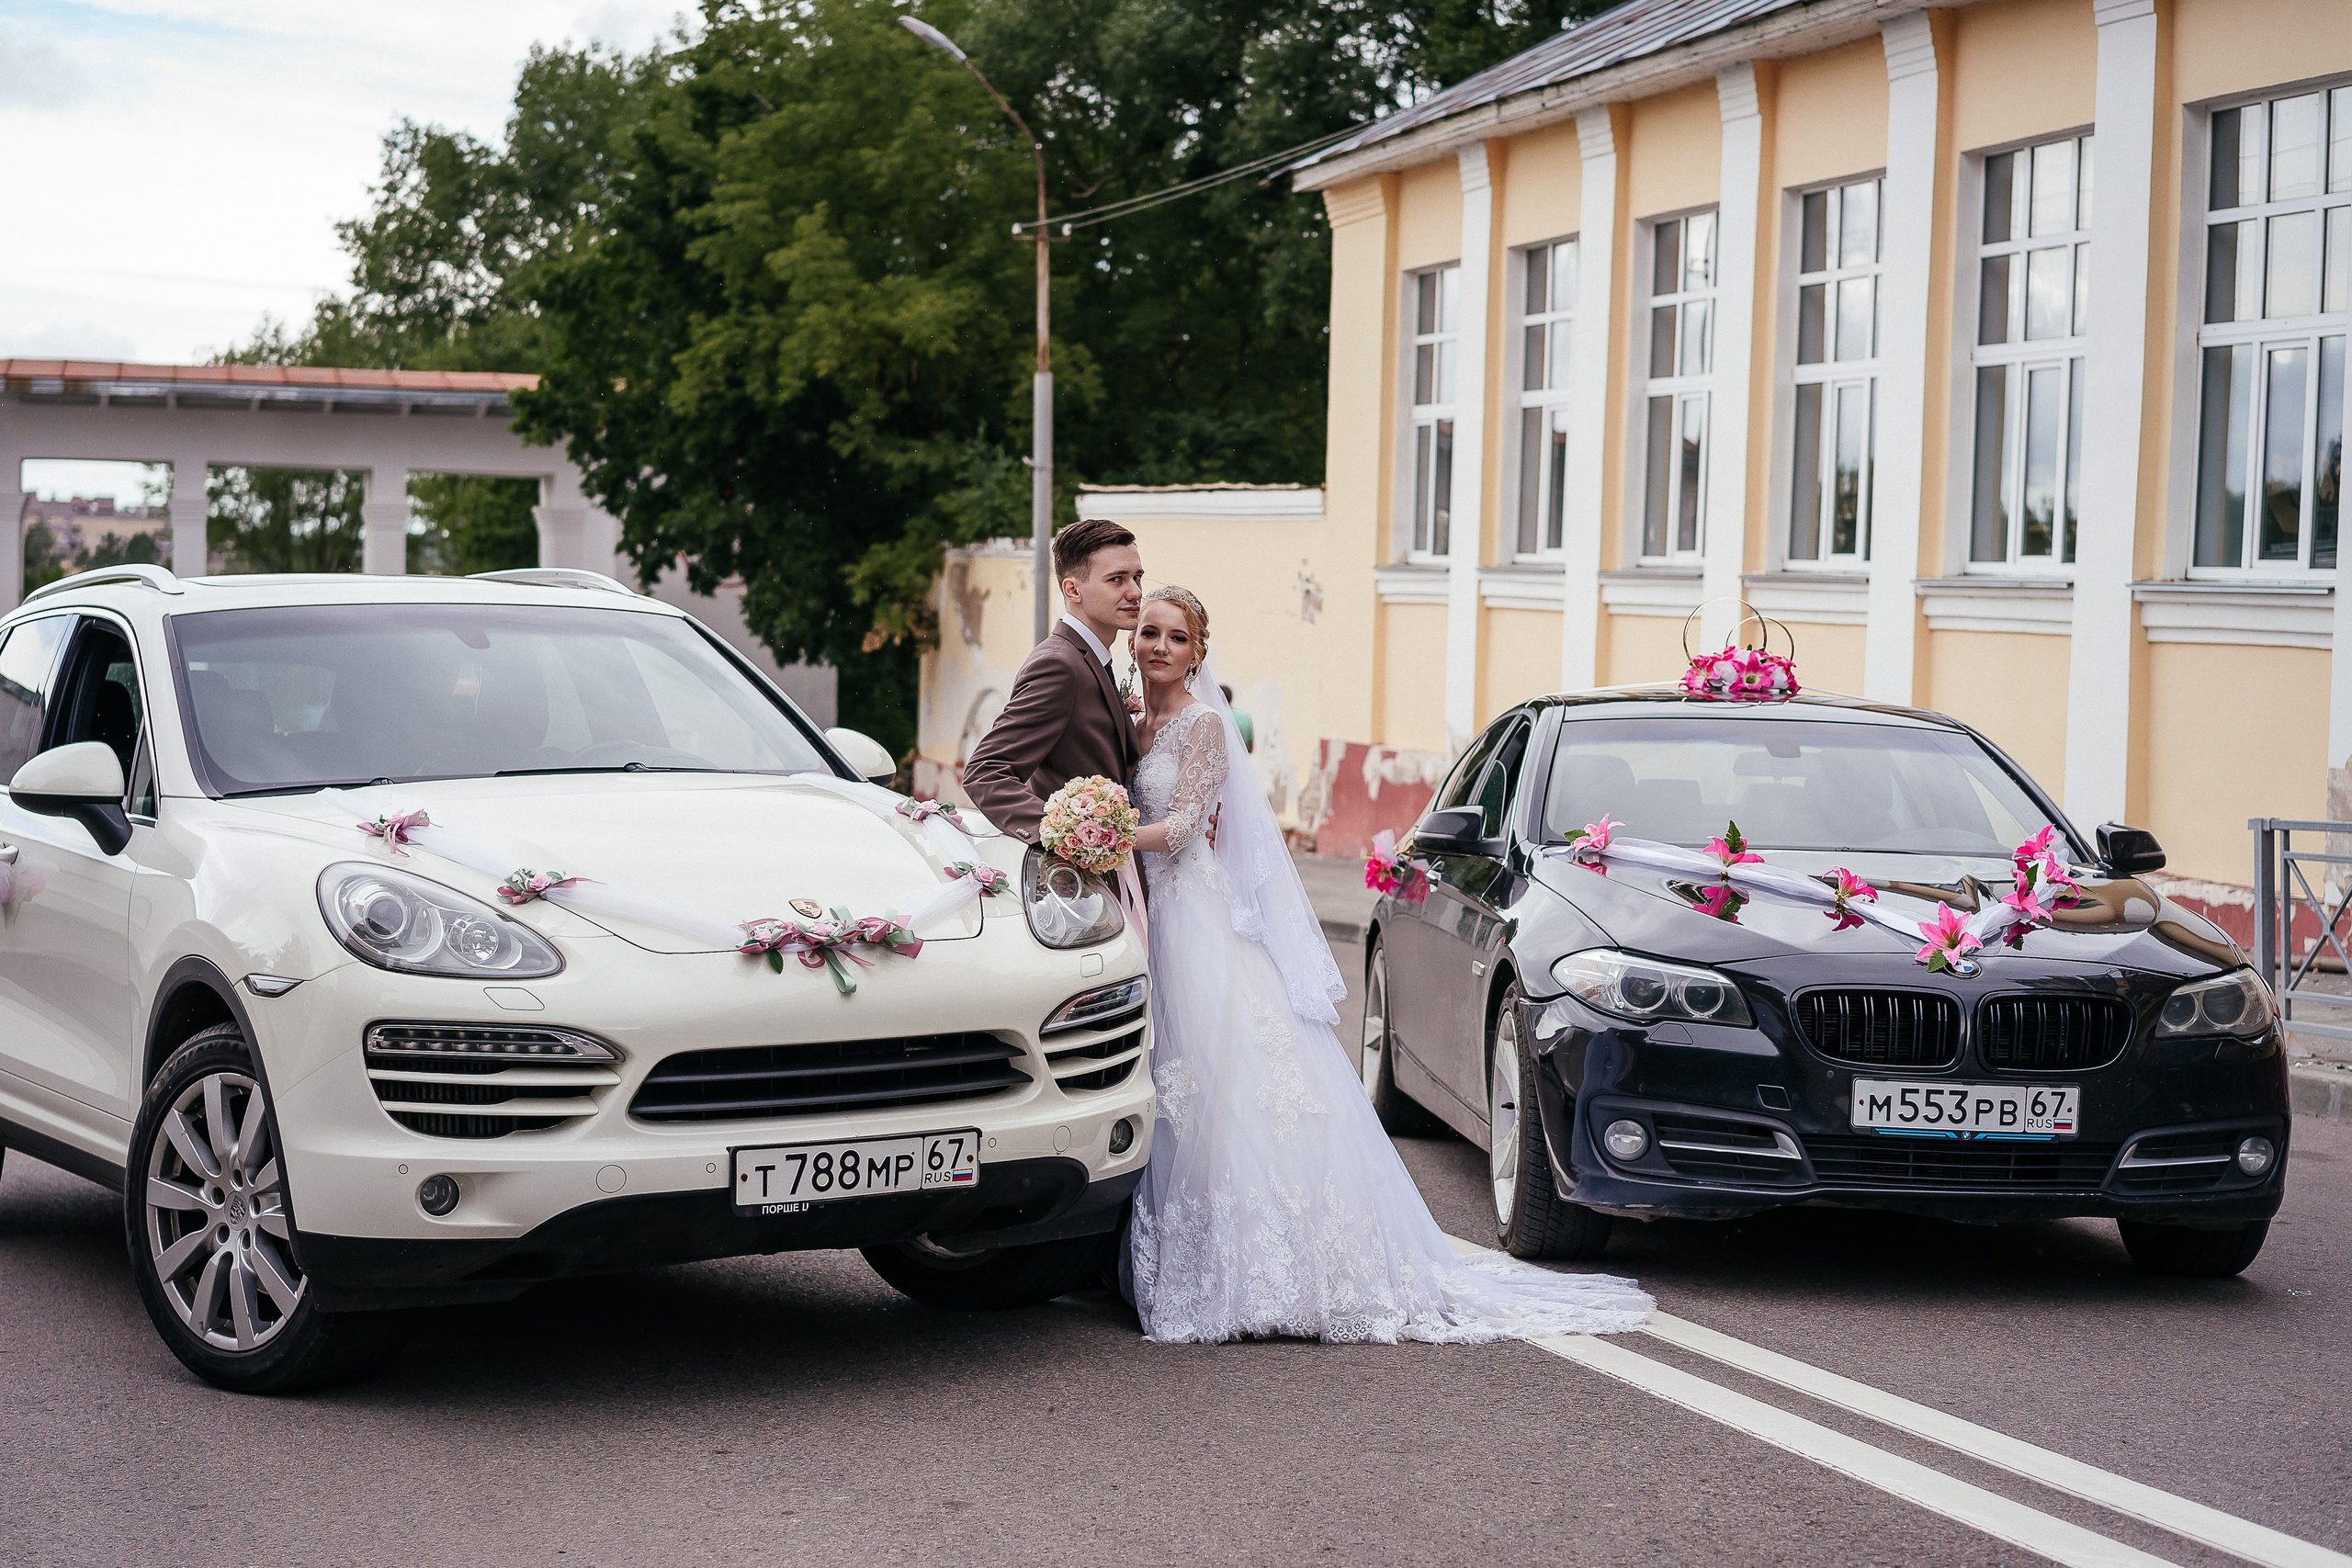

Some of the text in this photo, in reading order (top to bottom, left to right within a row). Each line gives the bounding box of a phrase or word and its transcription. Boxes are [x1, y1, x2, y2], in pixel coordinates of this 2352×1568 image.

[1868, 1088, 2066, 1126] М553РВ 67
[2027, 1118, 2052, 1129] RUS
[754, 1138, 965, 1197] Т788МР 67
[924, 1171, 951, 1184] RUS
[762, 1202, 799, 1214] ПОРШЕ
